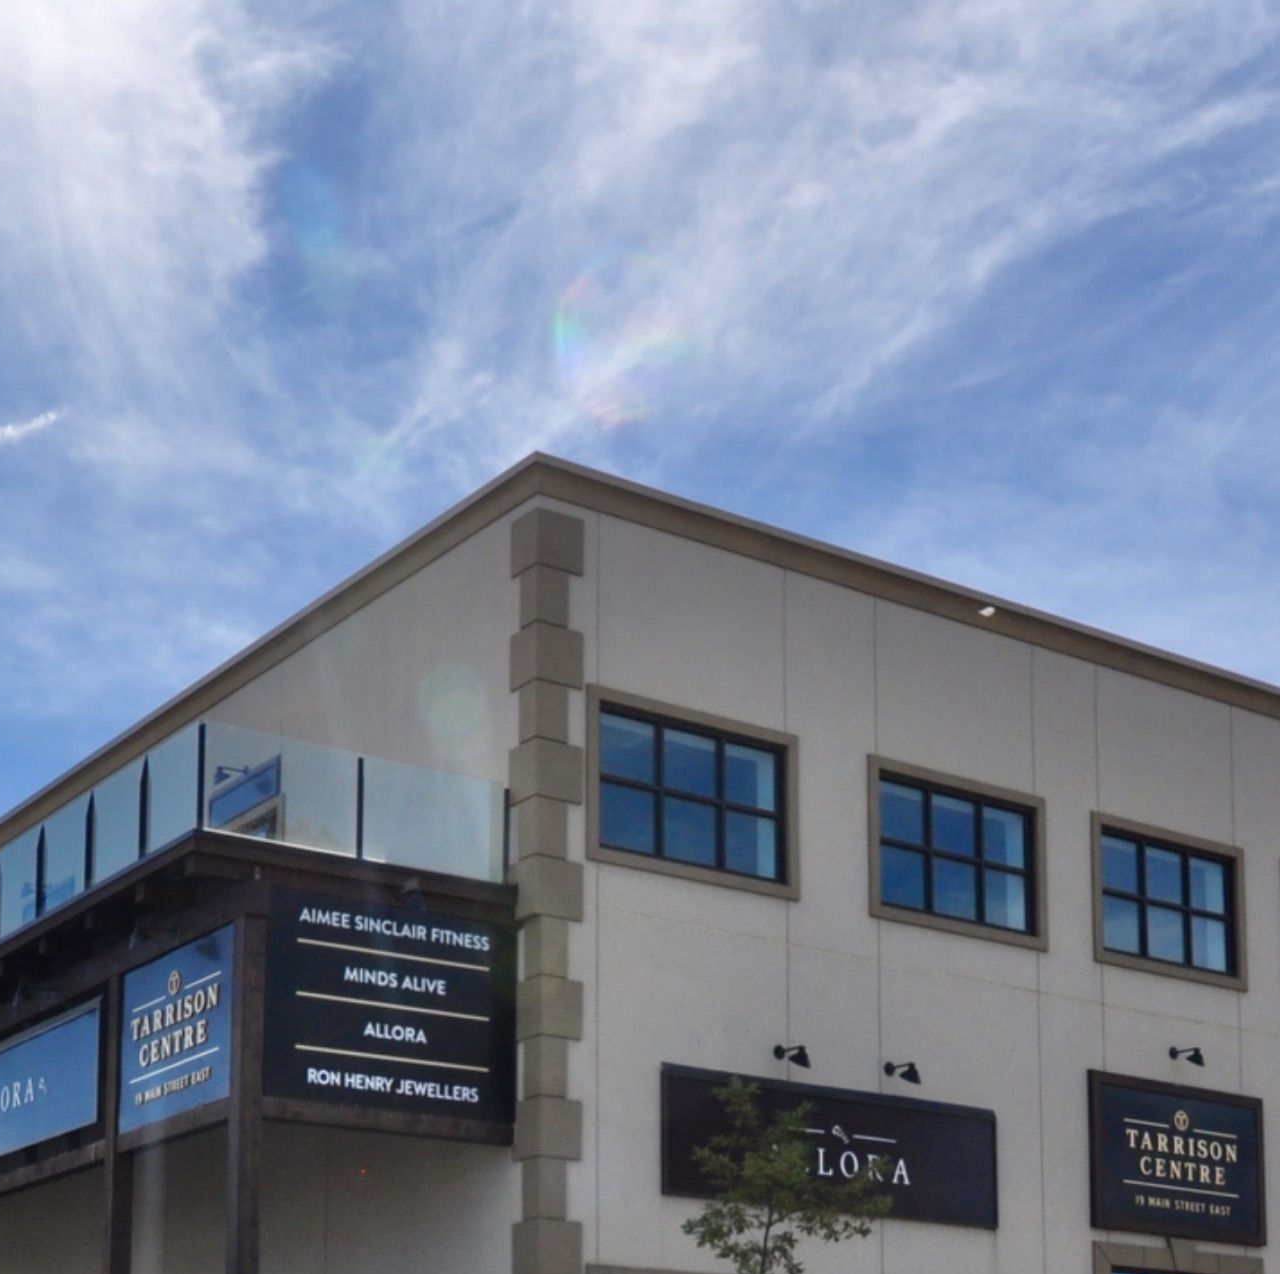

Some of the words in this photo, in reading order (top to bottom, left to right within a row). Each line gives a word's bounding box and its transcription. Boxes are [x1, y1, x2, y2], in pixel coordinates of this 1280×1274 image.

[299, 907, 351, 929] AIMEE
[354, 915, 428, 941] SINCLAIR
[431, 928, 490, 951] FITNESS
[344, 966, 398, 989] MINDS
[401, 976, 447, 996] ALIVE
[130, 982, 219, 1041] TARRISON
[138, 1019, 208, 1068] CENTRE
[363, 1022, 428, 1044] ALLORA
[144, 1085, 161, 1104] MAIN
[164, 1073, 189, 1097] STREET
[191, 1065, 211, 1086] EAST
[307, 1067, 342, 1087] RON
[344, 1072, 394, 1093] HENRY
[396, 1079, 480, 1103] JEWELLERS
[1125, 1128, 1238, 1163] TARRISON
[1139, 1155, 1227, 1185] CENTRE
[1147, 1196, 1170, 1209] MAIN
[1174, 1199, 1206, 1213] STREET
[1209, 1203, 1231, 1216] EAST
